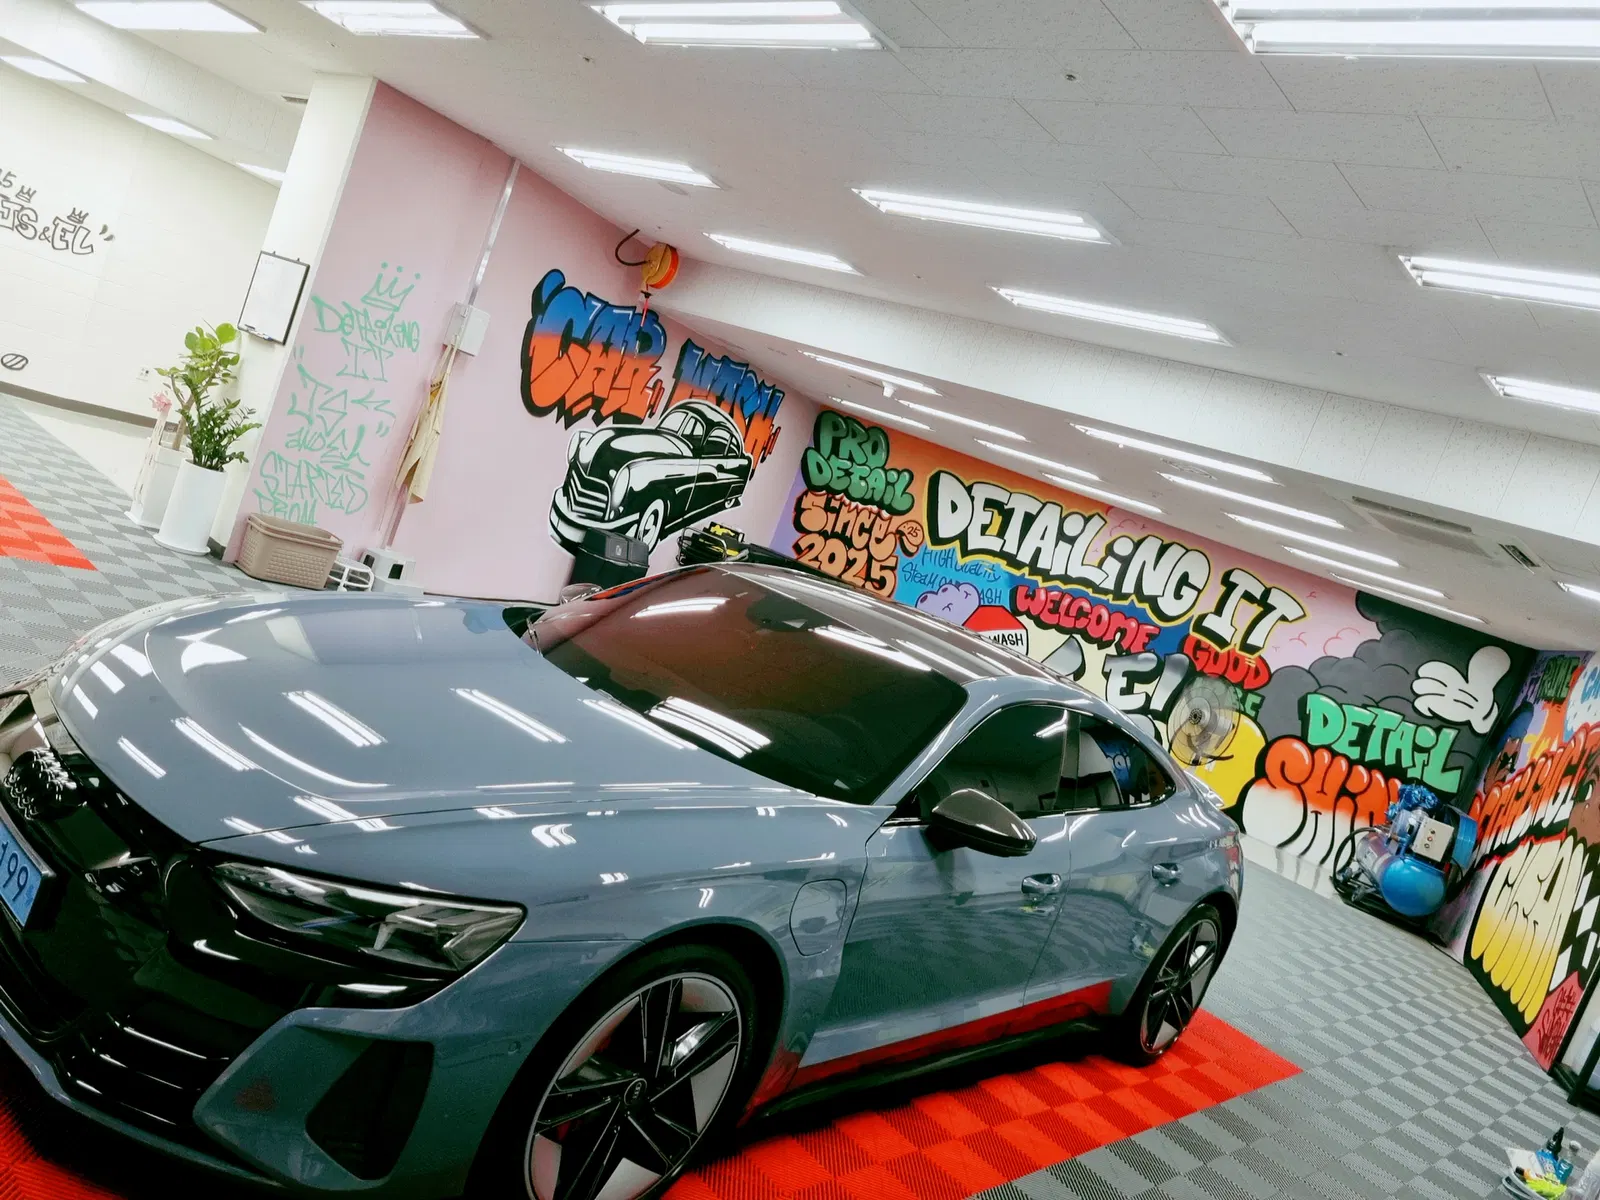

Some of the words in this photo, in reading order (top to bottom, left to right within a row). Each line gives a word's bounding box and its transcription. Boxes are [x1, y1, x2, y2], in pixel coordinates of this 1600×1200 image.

[336, 336, 394, 383] IT
[521, 268, 667, 430] CAR
[813, 410, 889, 470] PRO
[792, 533, 899, 598] 2025
[921, 544, 956, 569] HIGH
[979, 587, 1003, 605] ASH
[1191, 567, 1306, 656] IT
[1182, 633, 1272, 690] GOOD
